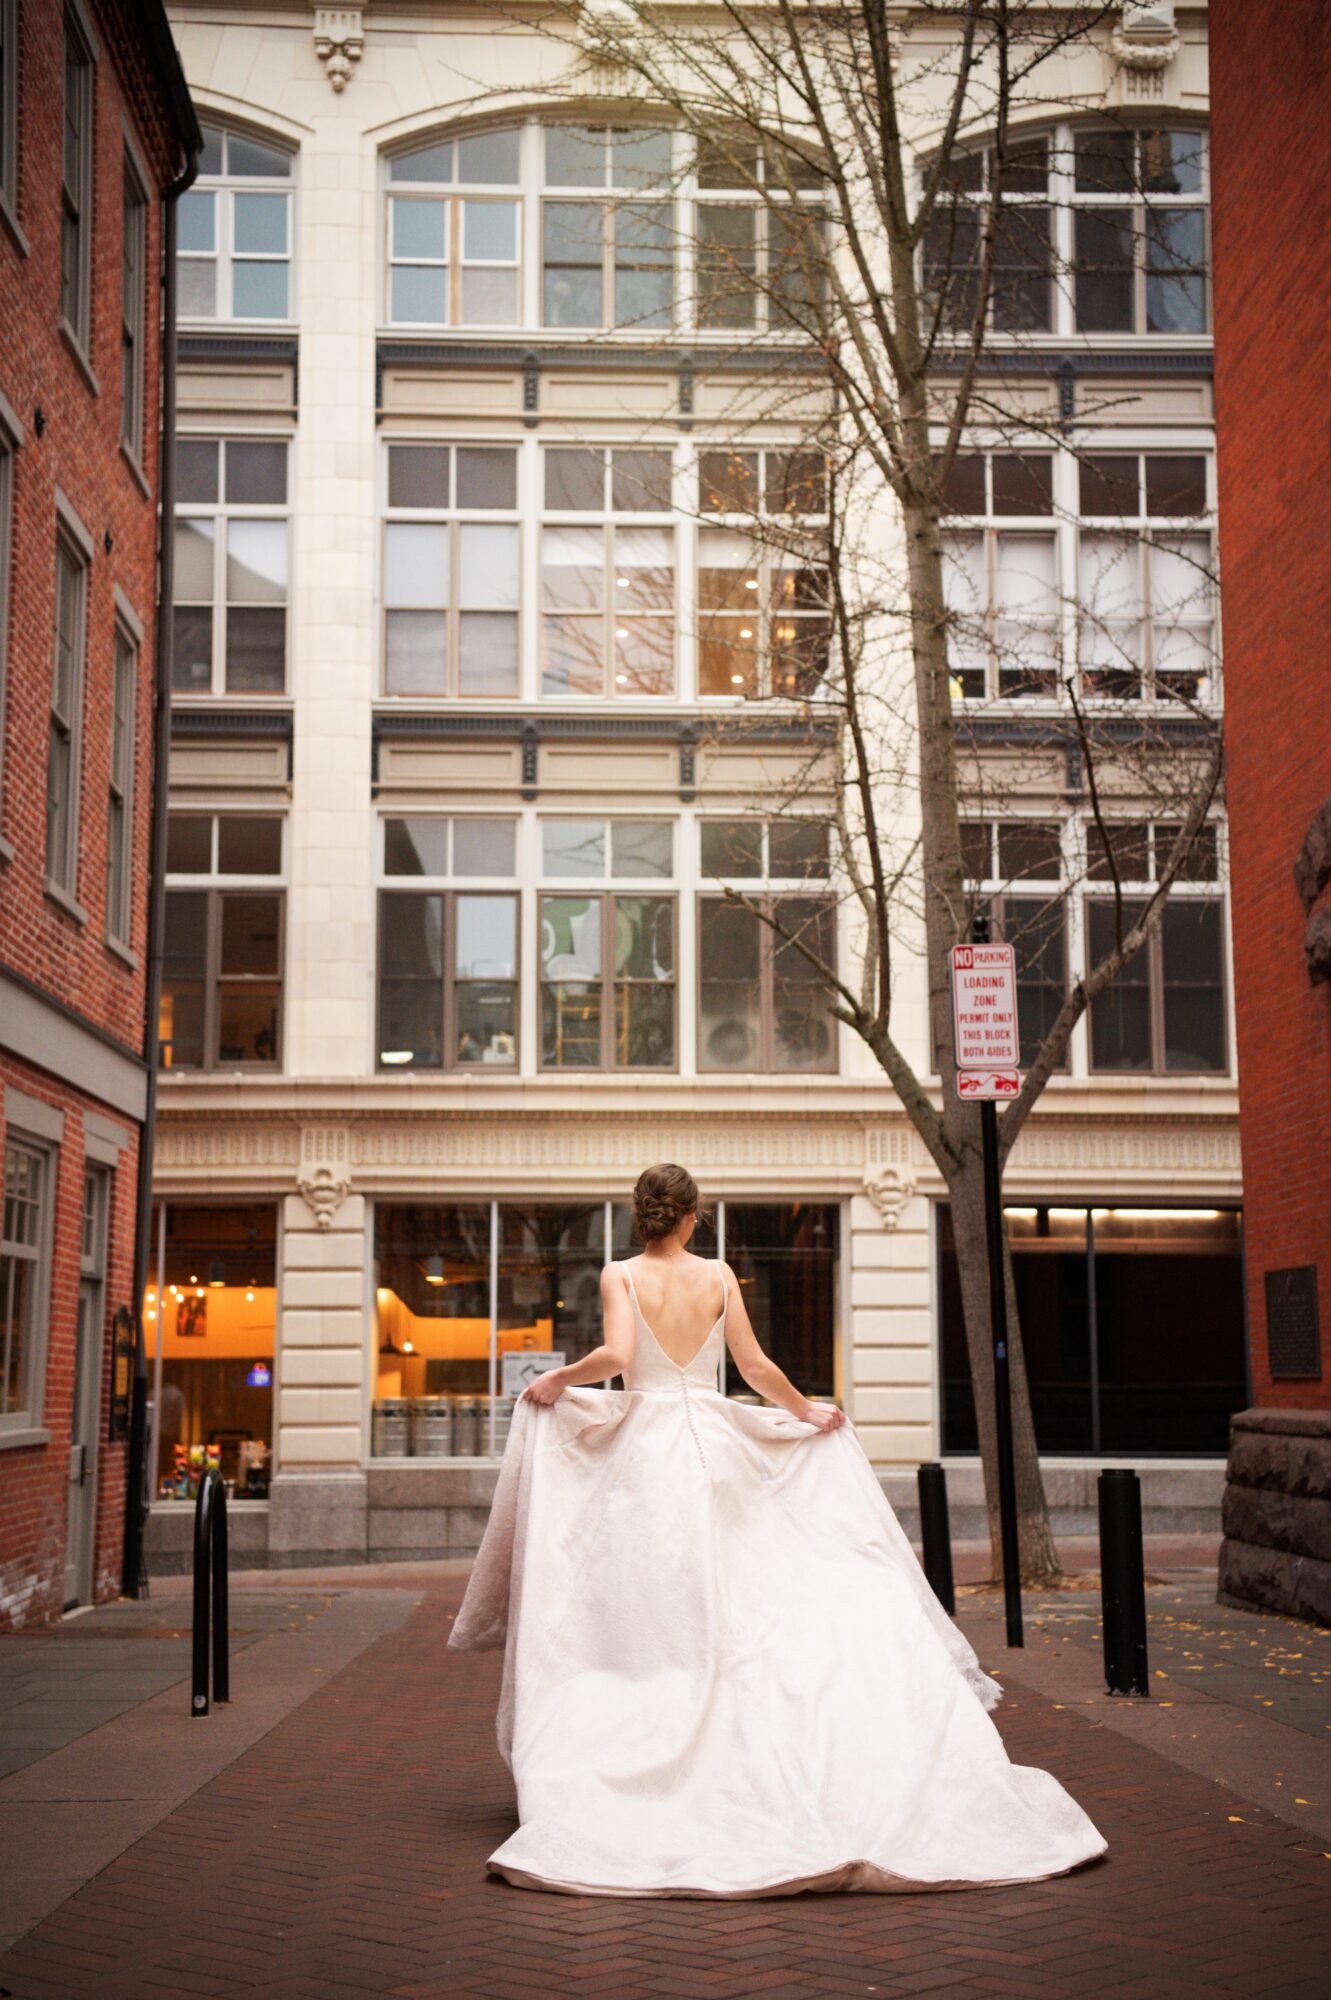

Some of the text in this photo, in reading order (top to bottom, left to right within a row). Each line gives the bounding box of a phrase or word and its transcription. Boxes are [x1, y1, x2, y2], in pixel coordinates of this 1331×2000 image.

[955, 949, 1010, 967] NO PARKING
[964, 976, 1005, 988] LOADING
[973, 995, 997, 1007] ZONE
[960, 1012, 1012, 1024] PERMIT ONLY
[963, 1029, 1011, 1041] THIS BLOCK
[963, 1046, 1012, 1057] BOTH SIDES
